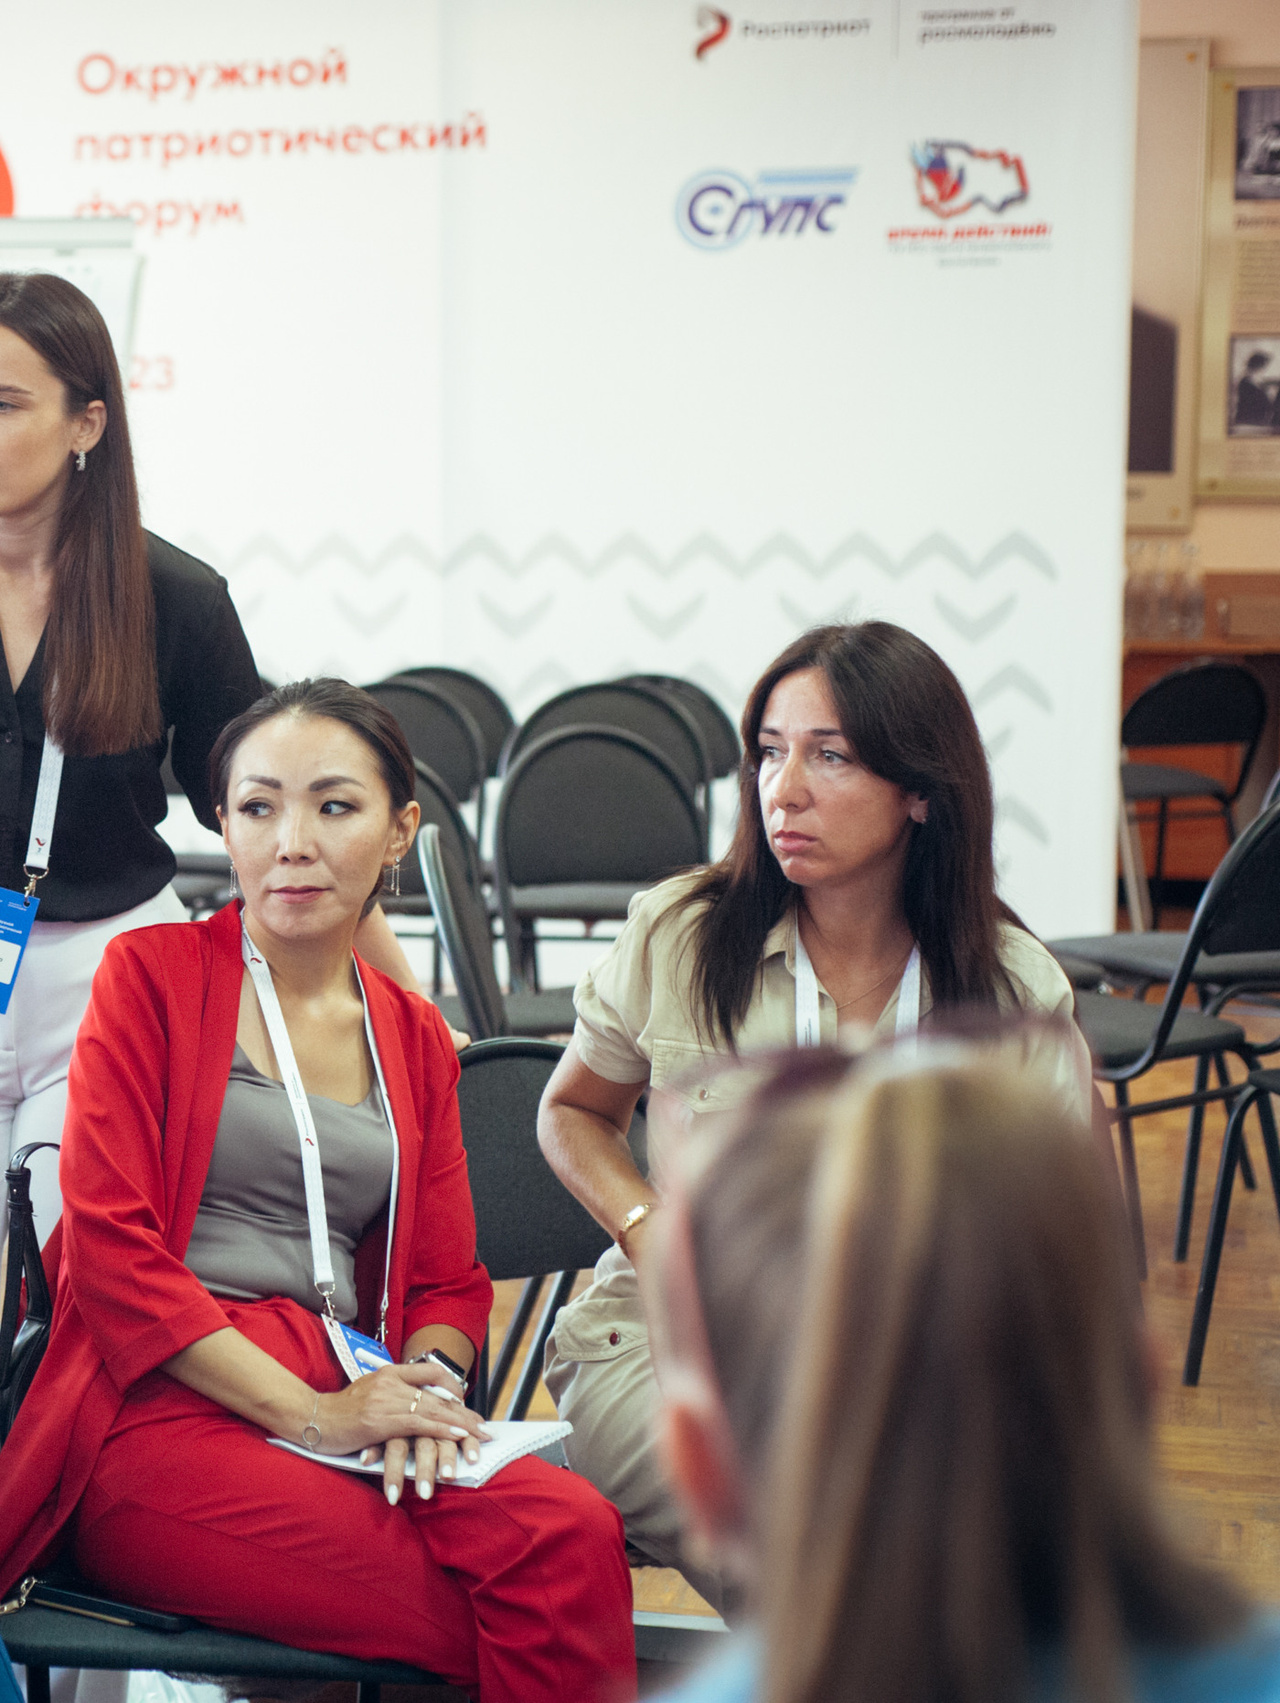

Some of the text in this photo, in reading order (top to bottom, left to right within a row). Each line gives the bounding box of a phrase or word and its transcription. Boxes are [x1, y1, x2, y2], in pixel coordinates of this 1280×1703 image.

[740, 18, 871, 40] Роспатриот
[76, 46, 348, 102] Окружной
[73, 111, 488, 170] патриотический
[128, 355, 177, 391] 23
